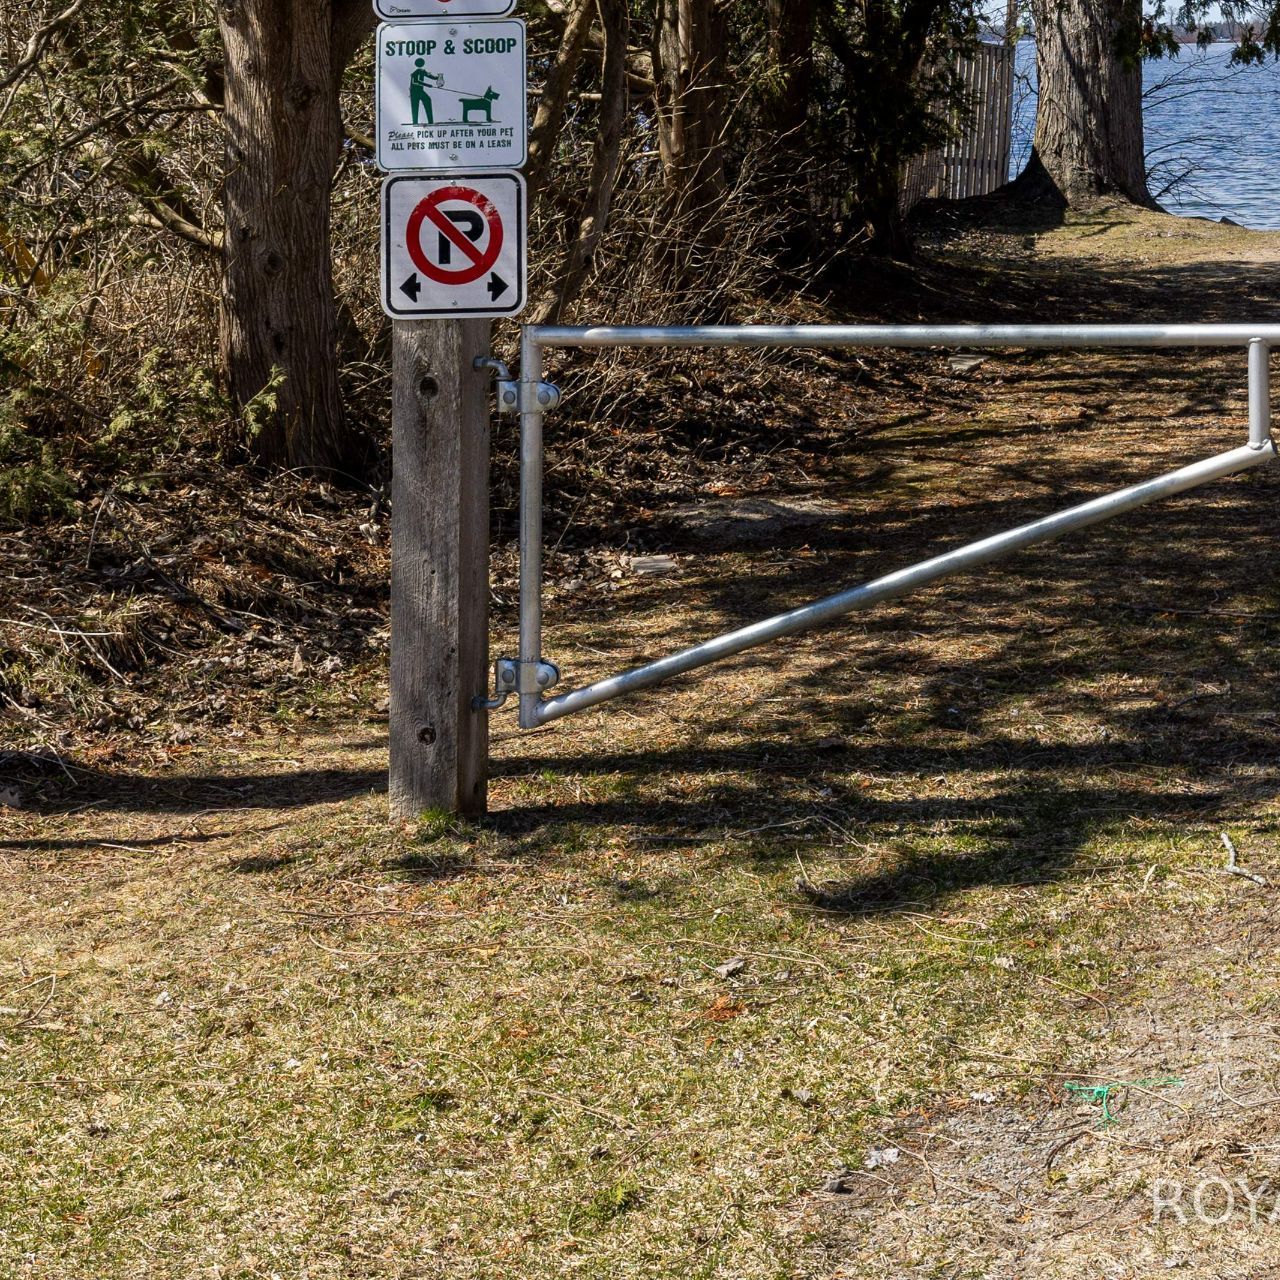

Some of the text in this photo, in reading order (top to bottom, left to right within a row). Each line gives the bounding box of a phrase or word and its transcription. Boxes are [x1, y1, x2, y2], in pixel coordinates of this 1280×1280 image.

[386, 38, 516, 56] STOOP & SCOOP
[417, 130, 435, 139] PICK
[437, 130, 447, 138] UP
[450, 129, 474, 138] AFTER
[477, 128, 497, 137] YOUR
[500, 127, 514, 137] PET
[391, 139, 512, 151] ALL PETS MUST BE ON A LEASH
